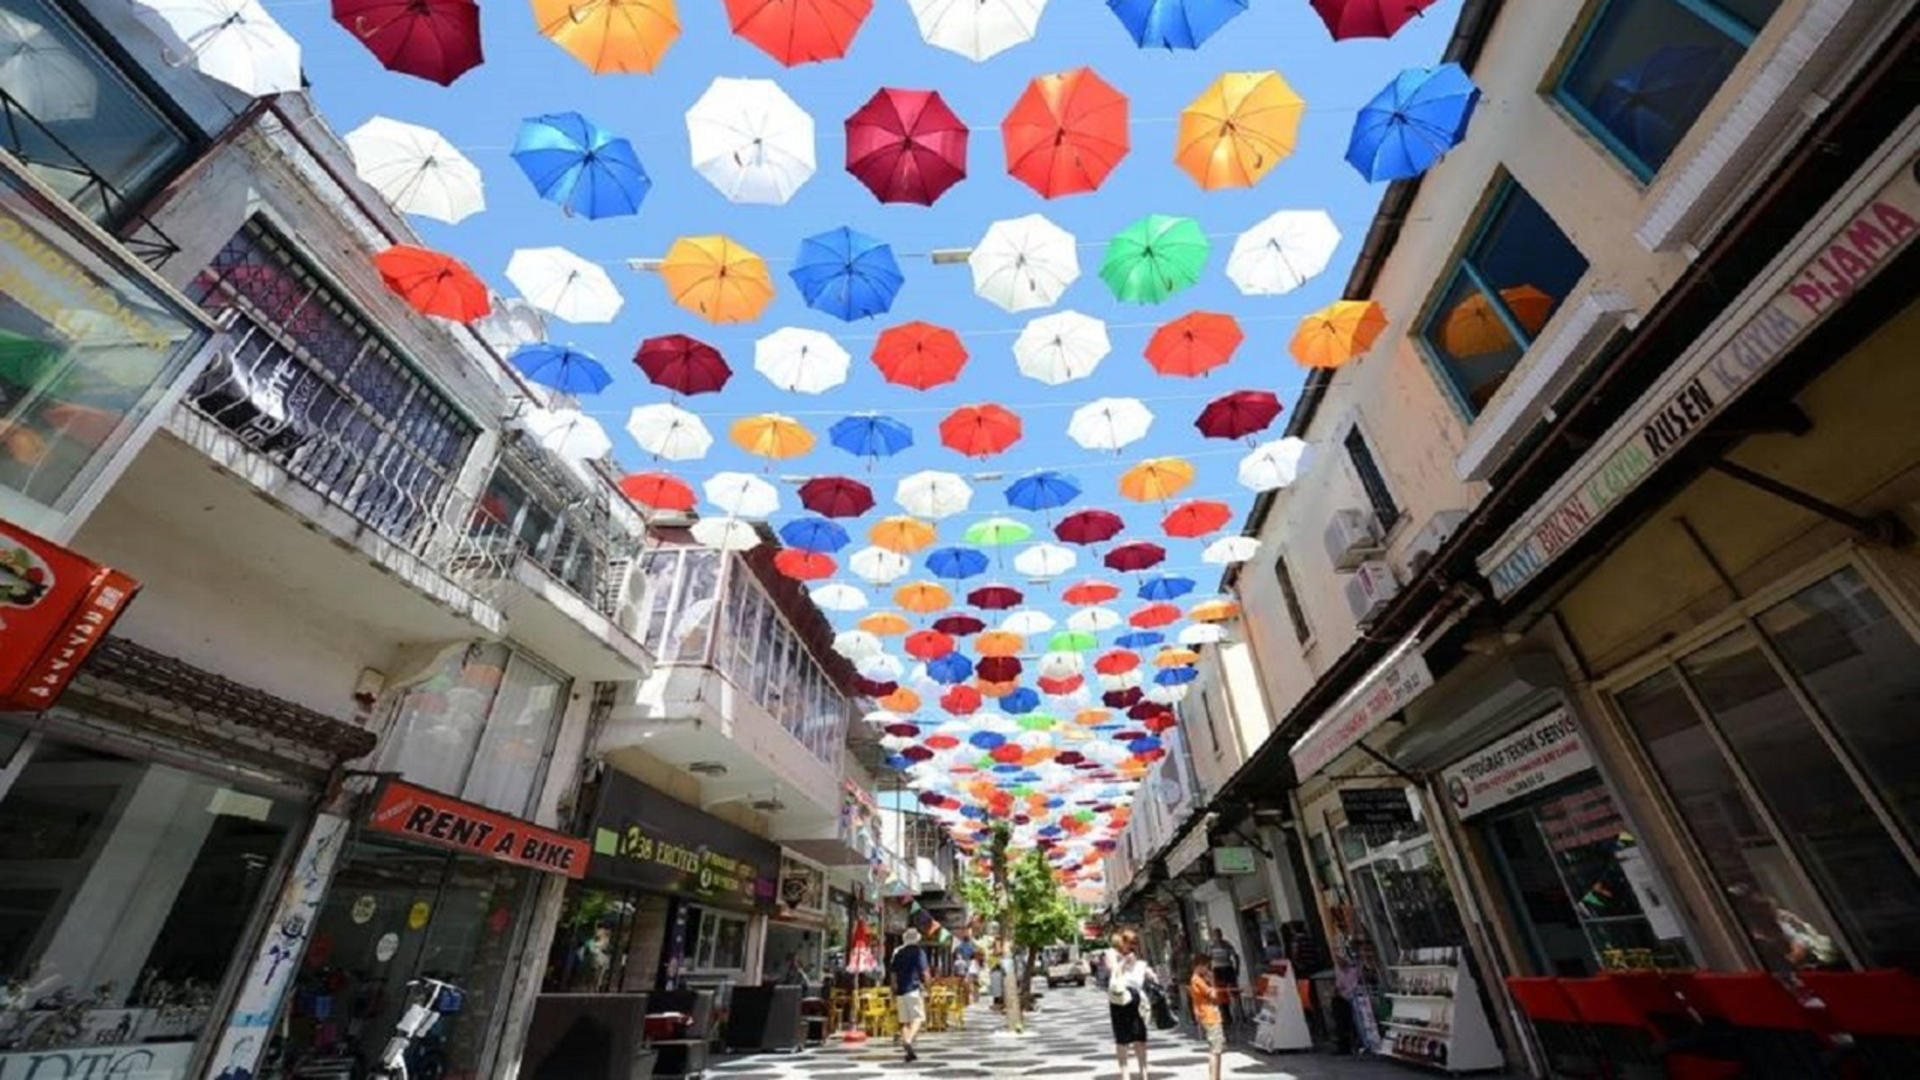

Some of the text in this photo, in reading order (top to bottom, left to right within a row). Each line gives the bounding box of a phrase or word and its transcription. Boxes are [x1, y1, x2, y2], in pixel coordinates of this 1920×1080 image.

[1788, 201, 1918, 316] PİJAMA
[403, 805, 493, 847] RENT
[494, 831, 516, 854] A
[520, 838, 576, 870] BIKE
